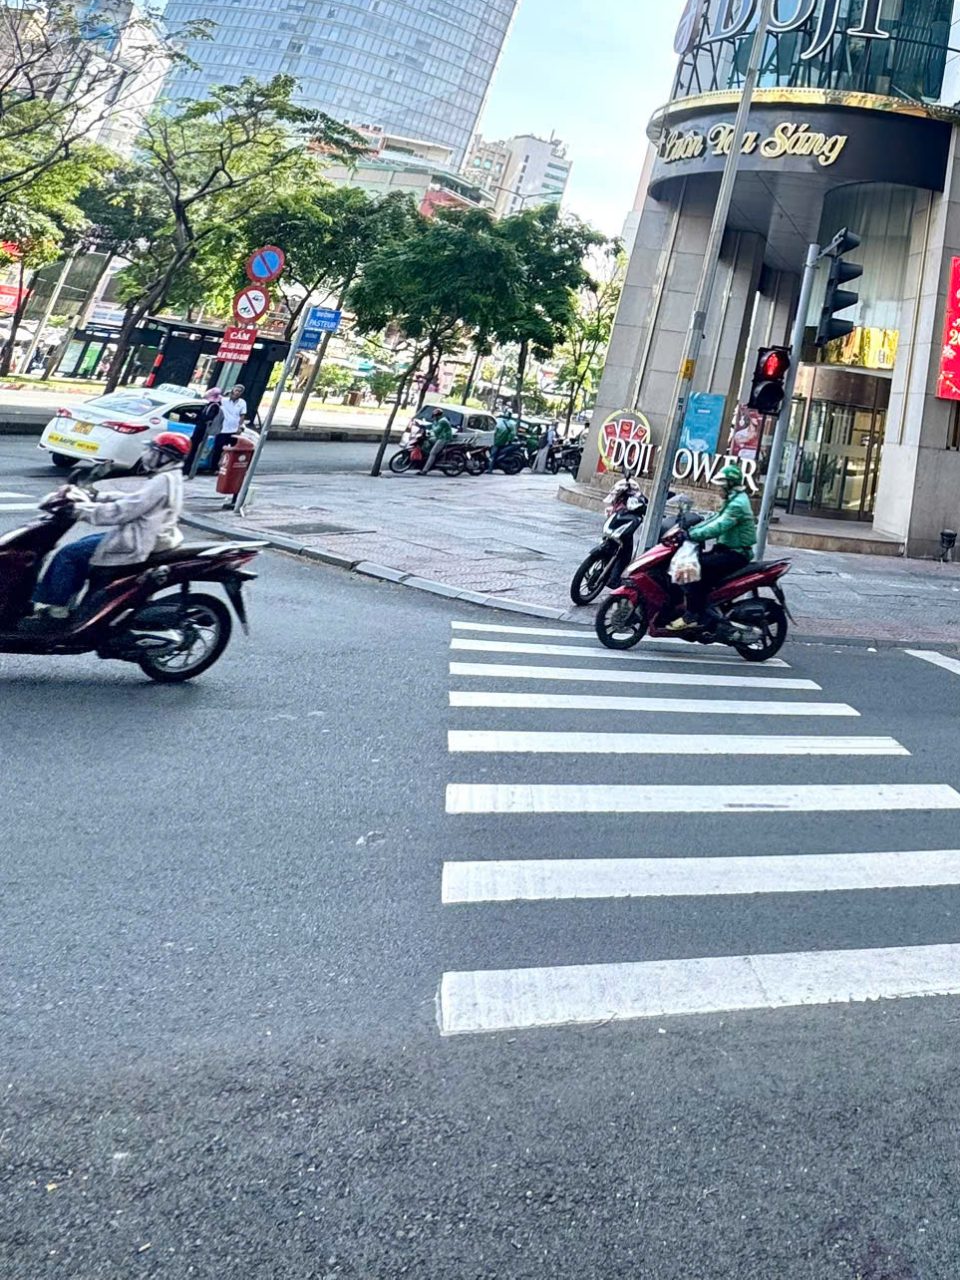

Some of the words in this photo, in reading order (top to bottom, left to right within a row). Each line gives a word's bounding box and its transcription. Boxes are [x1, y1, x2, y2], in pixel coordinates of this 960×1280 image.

[760, 122, 848, 166] Sáng
[309, 319, 337, 329] PASTEUR
[610, 436, 653, 478] DOJI
[657, 446, 759, 496] OWR
